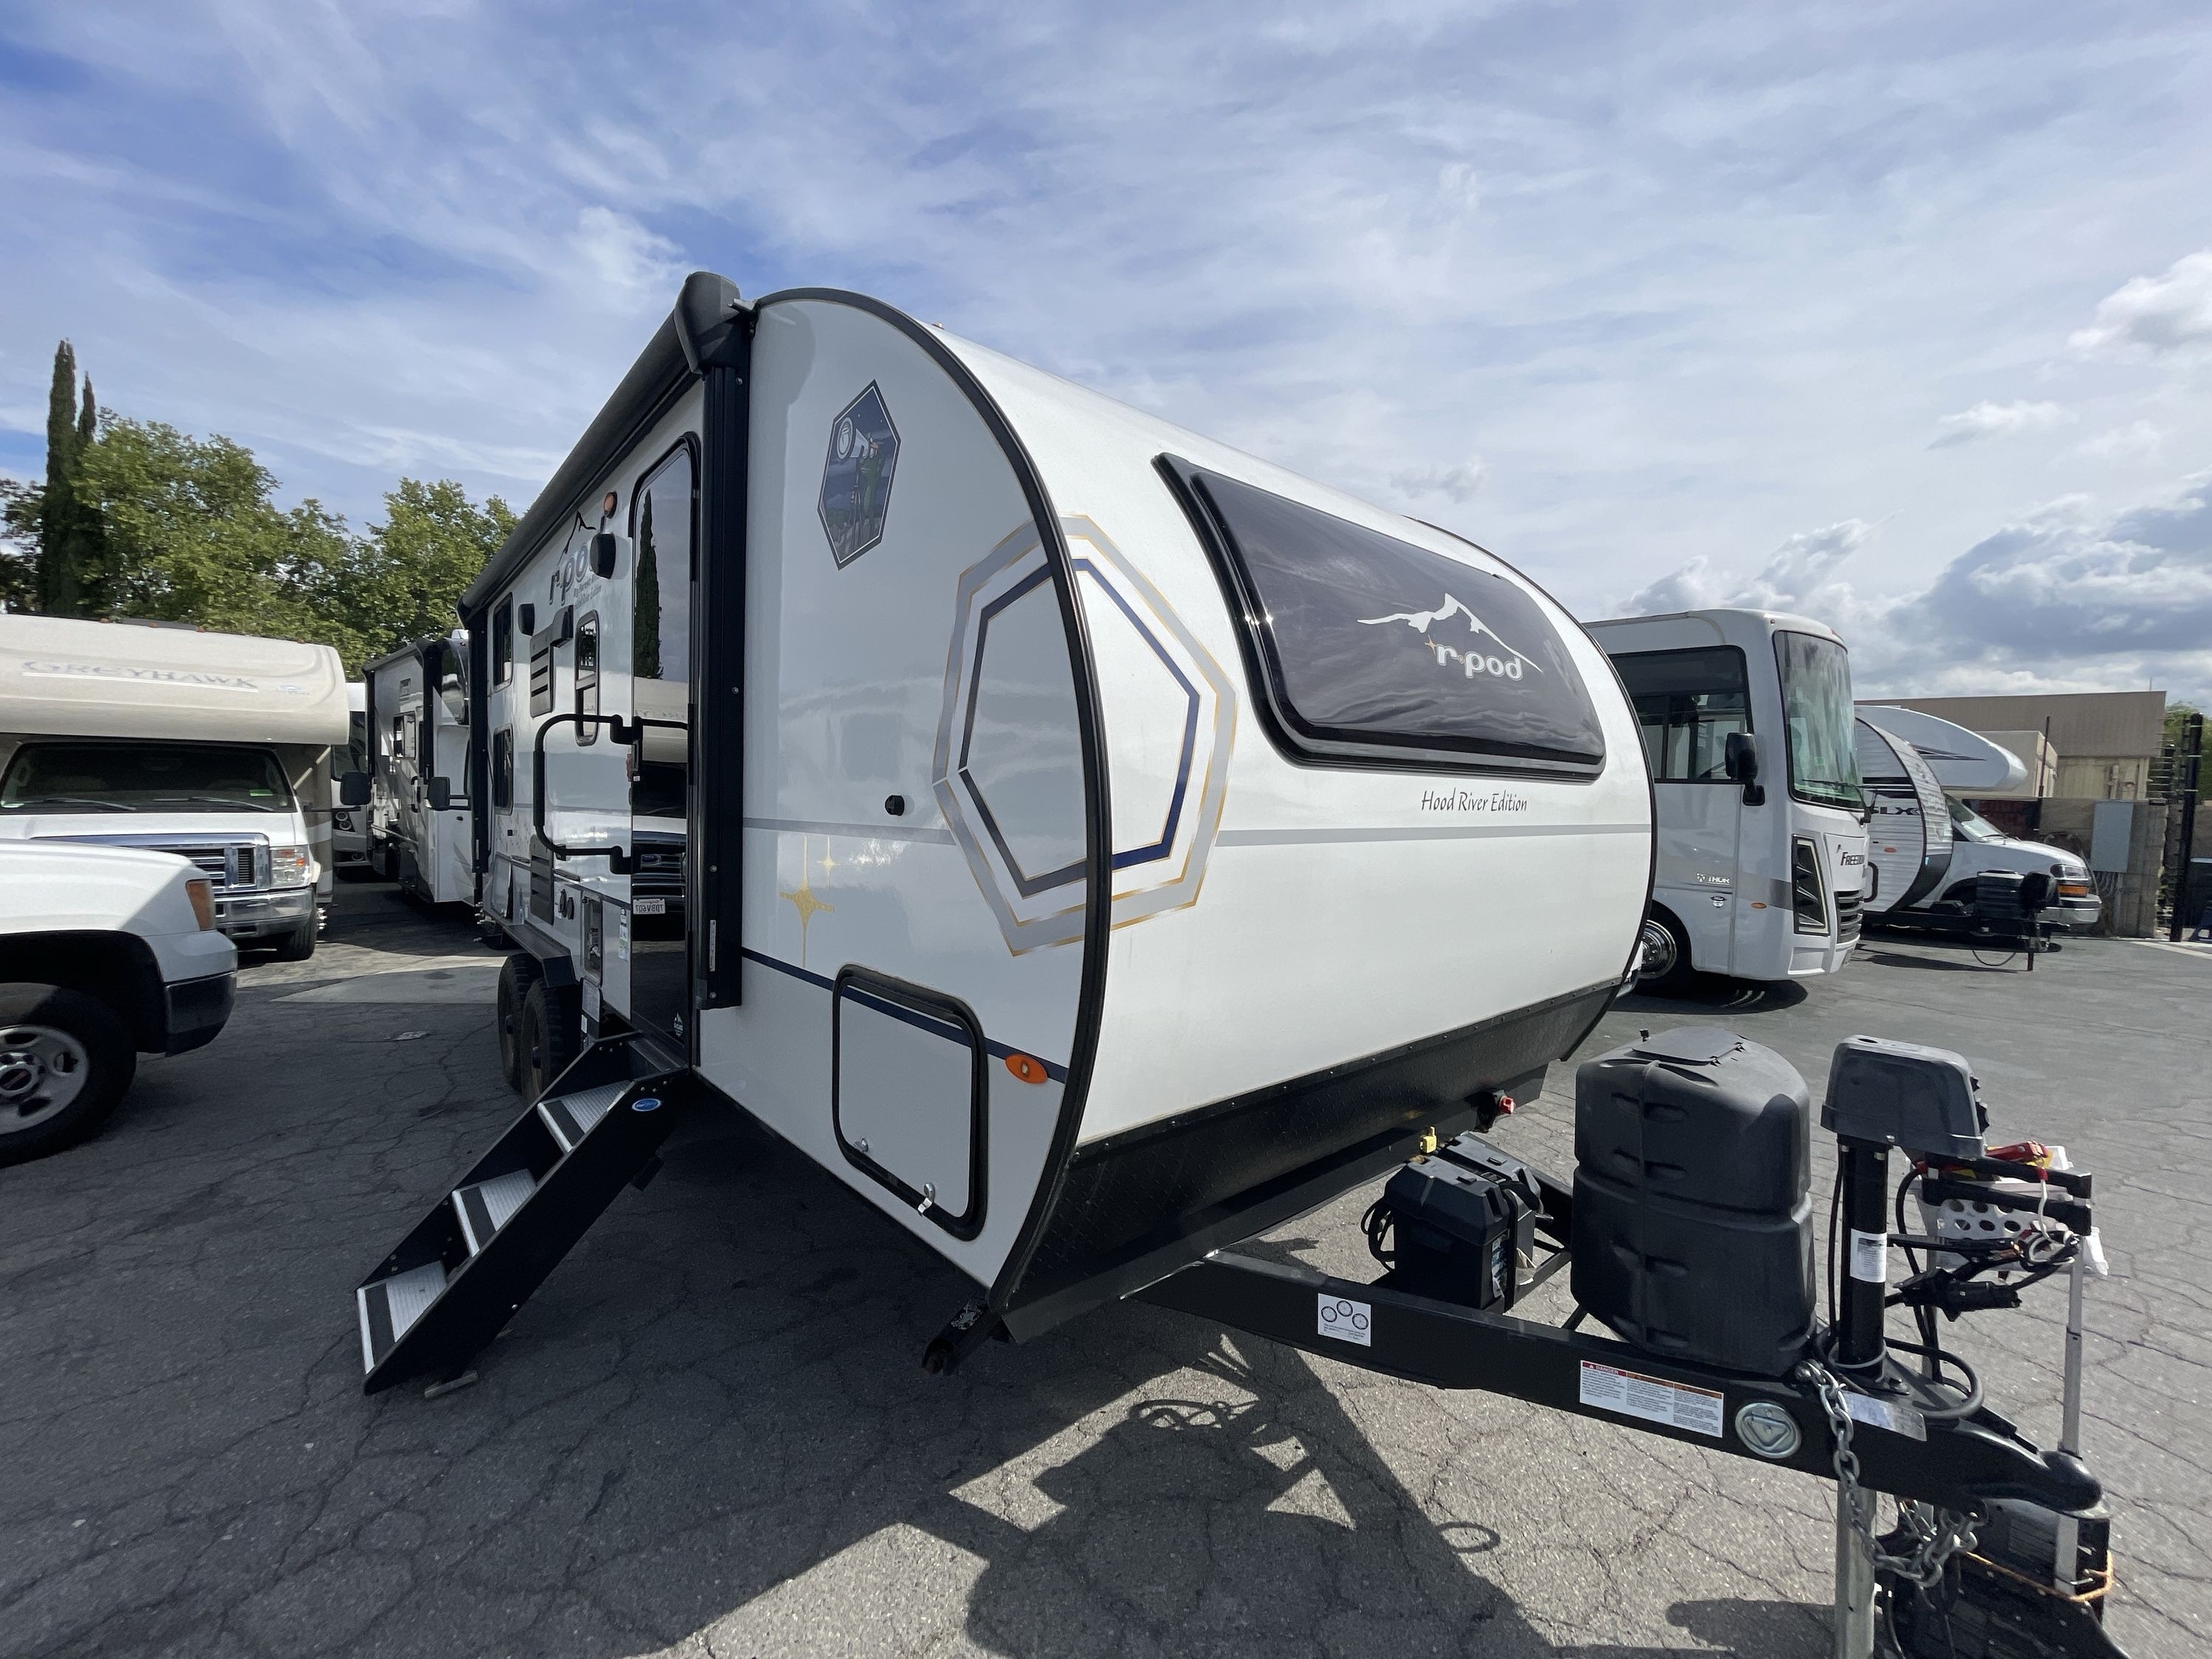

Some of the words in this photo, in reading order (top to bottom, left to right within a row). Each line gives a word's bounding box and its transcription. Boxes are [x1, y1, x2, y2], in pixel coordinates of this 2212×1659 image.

[1421, 787, 1456, 811] Hood
[1458, 791, 1489, 812] River
[1491, 790, 1528, 812] Edition
[1596, 1366, 1619, 1375] DANGER
